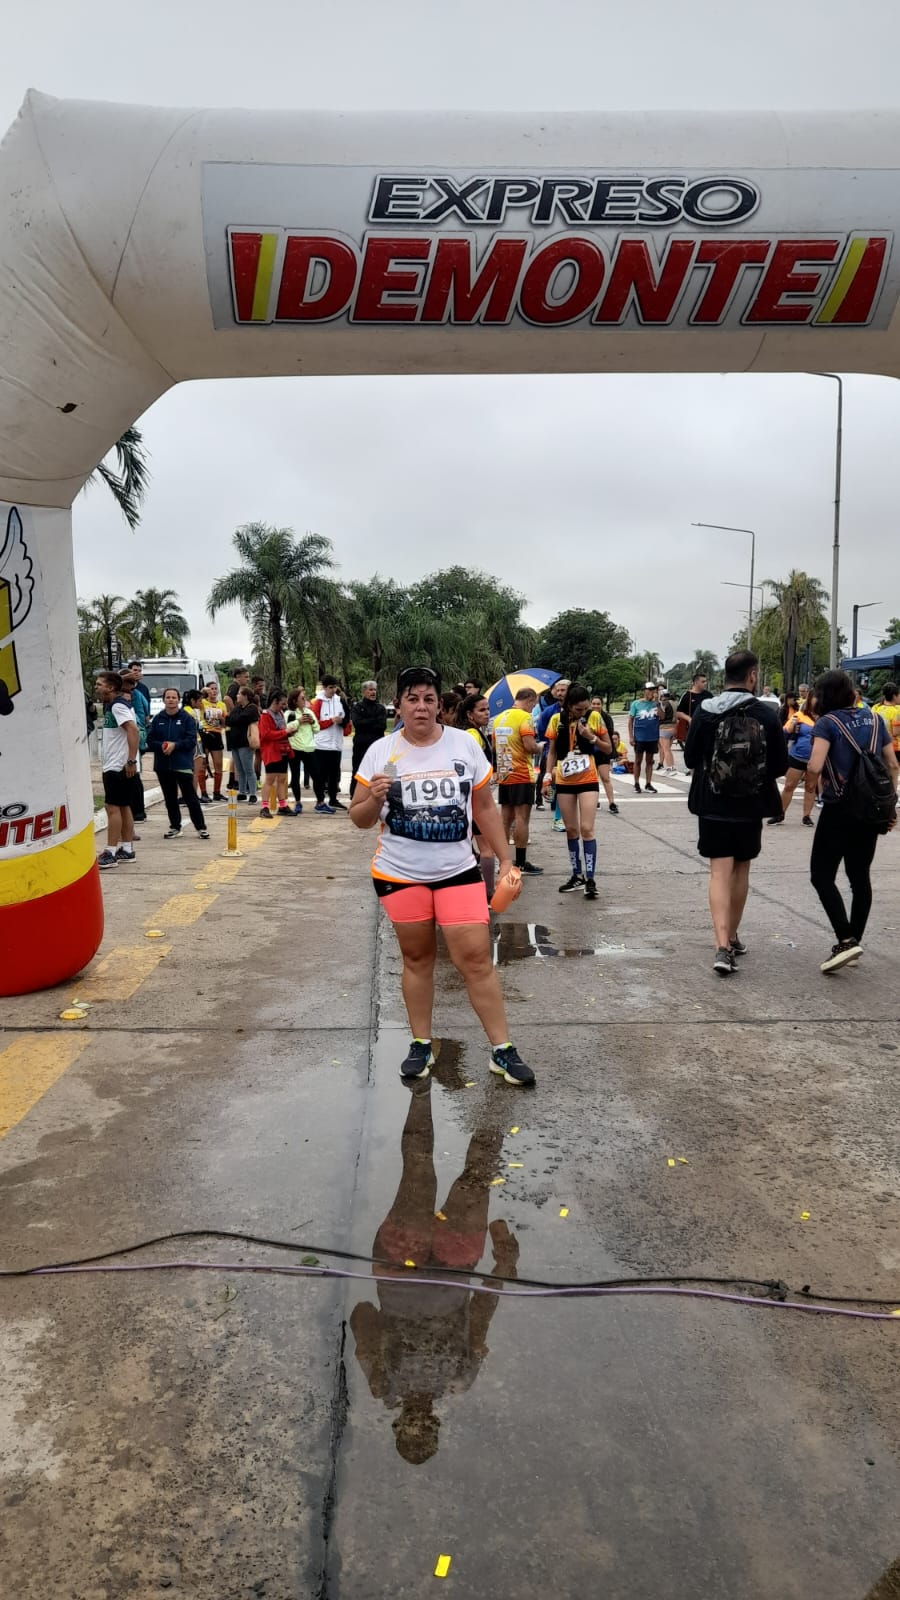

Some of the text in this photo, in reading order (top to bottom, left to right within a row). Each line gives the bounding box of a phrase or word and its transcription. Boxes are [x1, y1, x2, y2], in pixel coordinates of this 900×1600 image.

[369, 175, 760, 225] EXPRESO
[273, 233, 843, 325] DEMONTE
[562, 759, 587, 773] 231
[405, 778, 456, 803] 190
